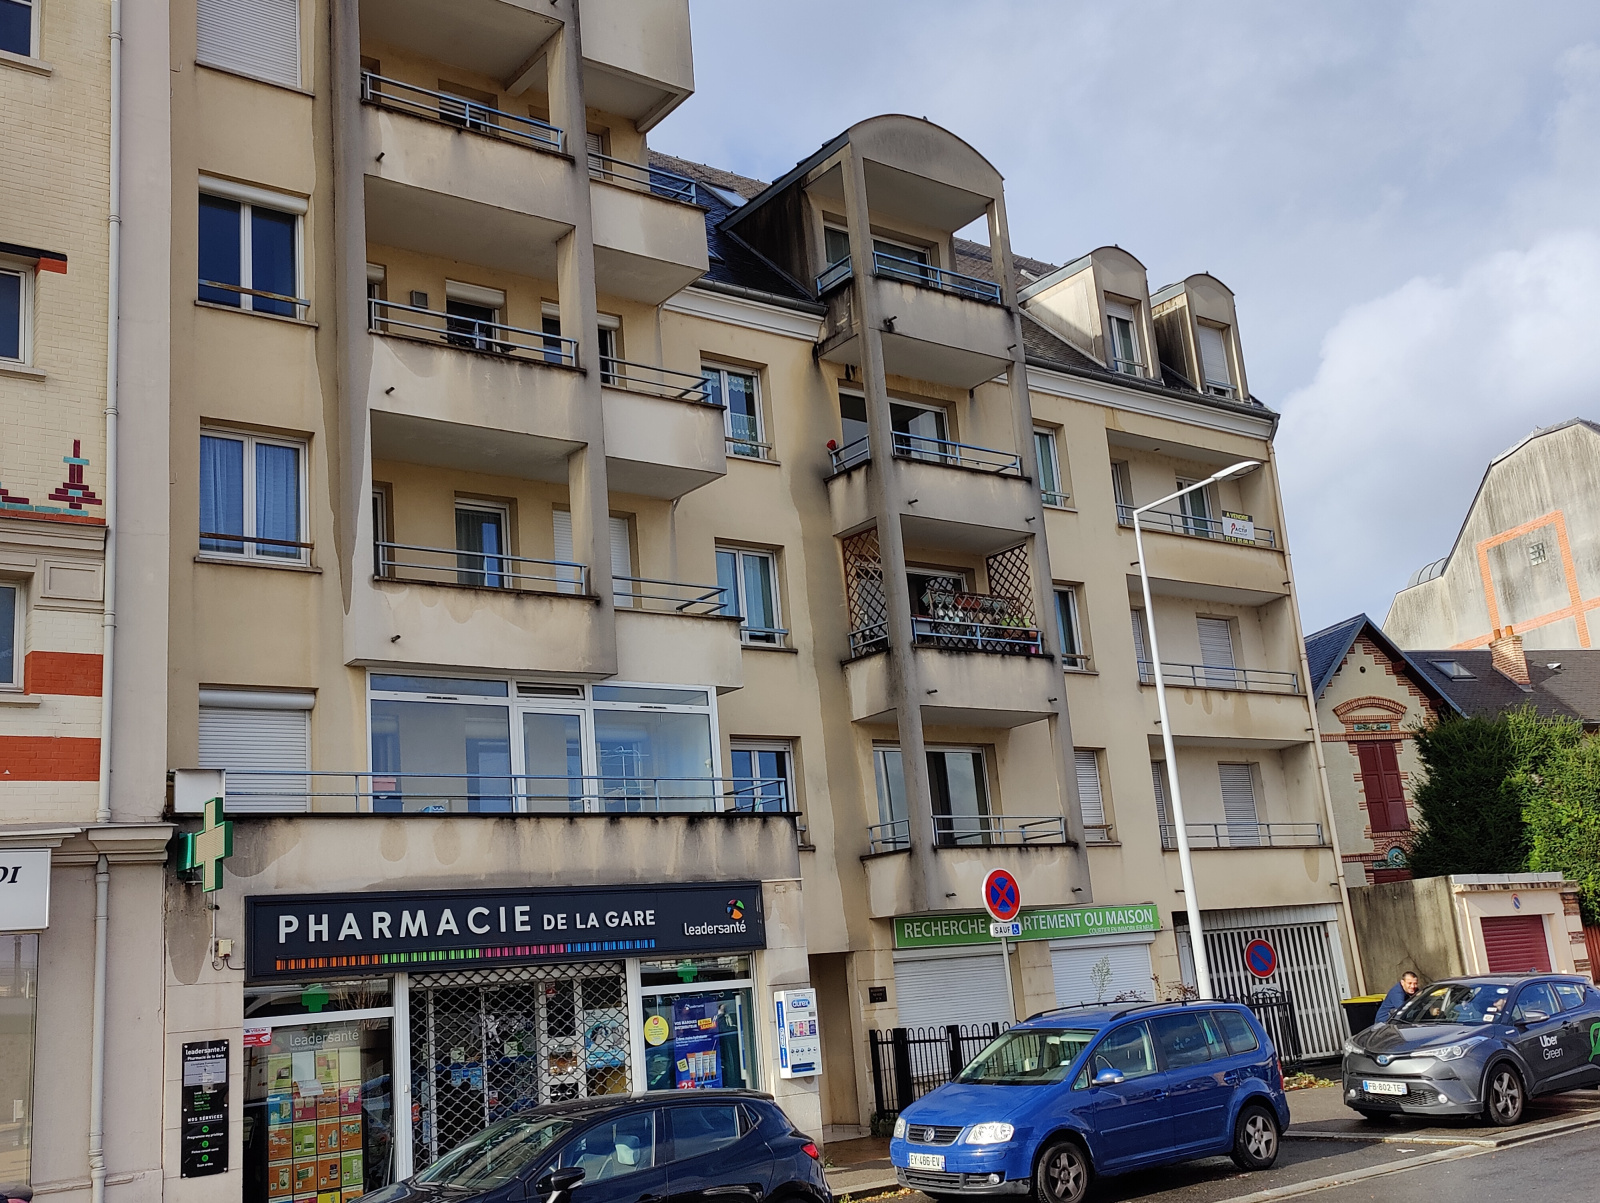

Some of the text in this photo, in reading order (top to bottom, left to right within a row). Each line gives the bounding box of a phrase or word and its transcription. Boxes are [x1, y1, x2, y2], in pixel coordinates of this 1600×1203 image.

[278, 905, 656, 944] PHARMACIE DE LA GARE
[684, 919, 747, 936] leadersanté
[904, 908, 1153, 938] RECHERCHE ARTEMENT OU MAISON
[995, 926, 1011, 934] SAUF
[1540, 1034, 1557, 1047] Uber
[185, 1046, 227, 1055] leadersante.fr
[1543, 1048, 1563, 1060] Green
